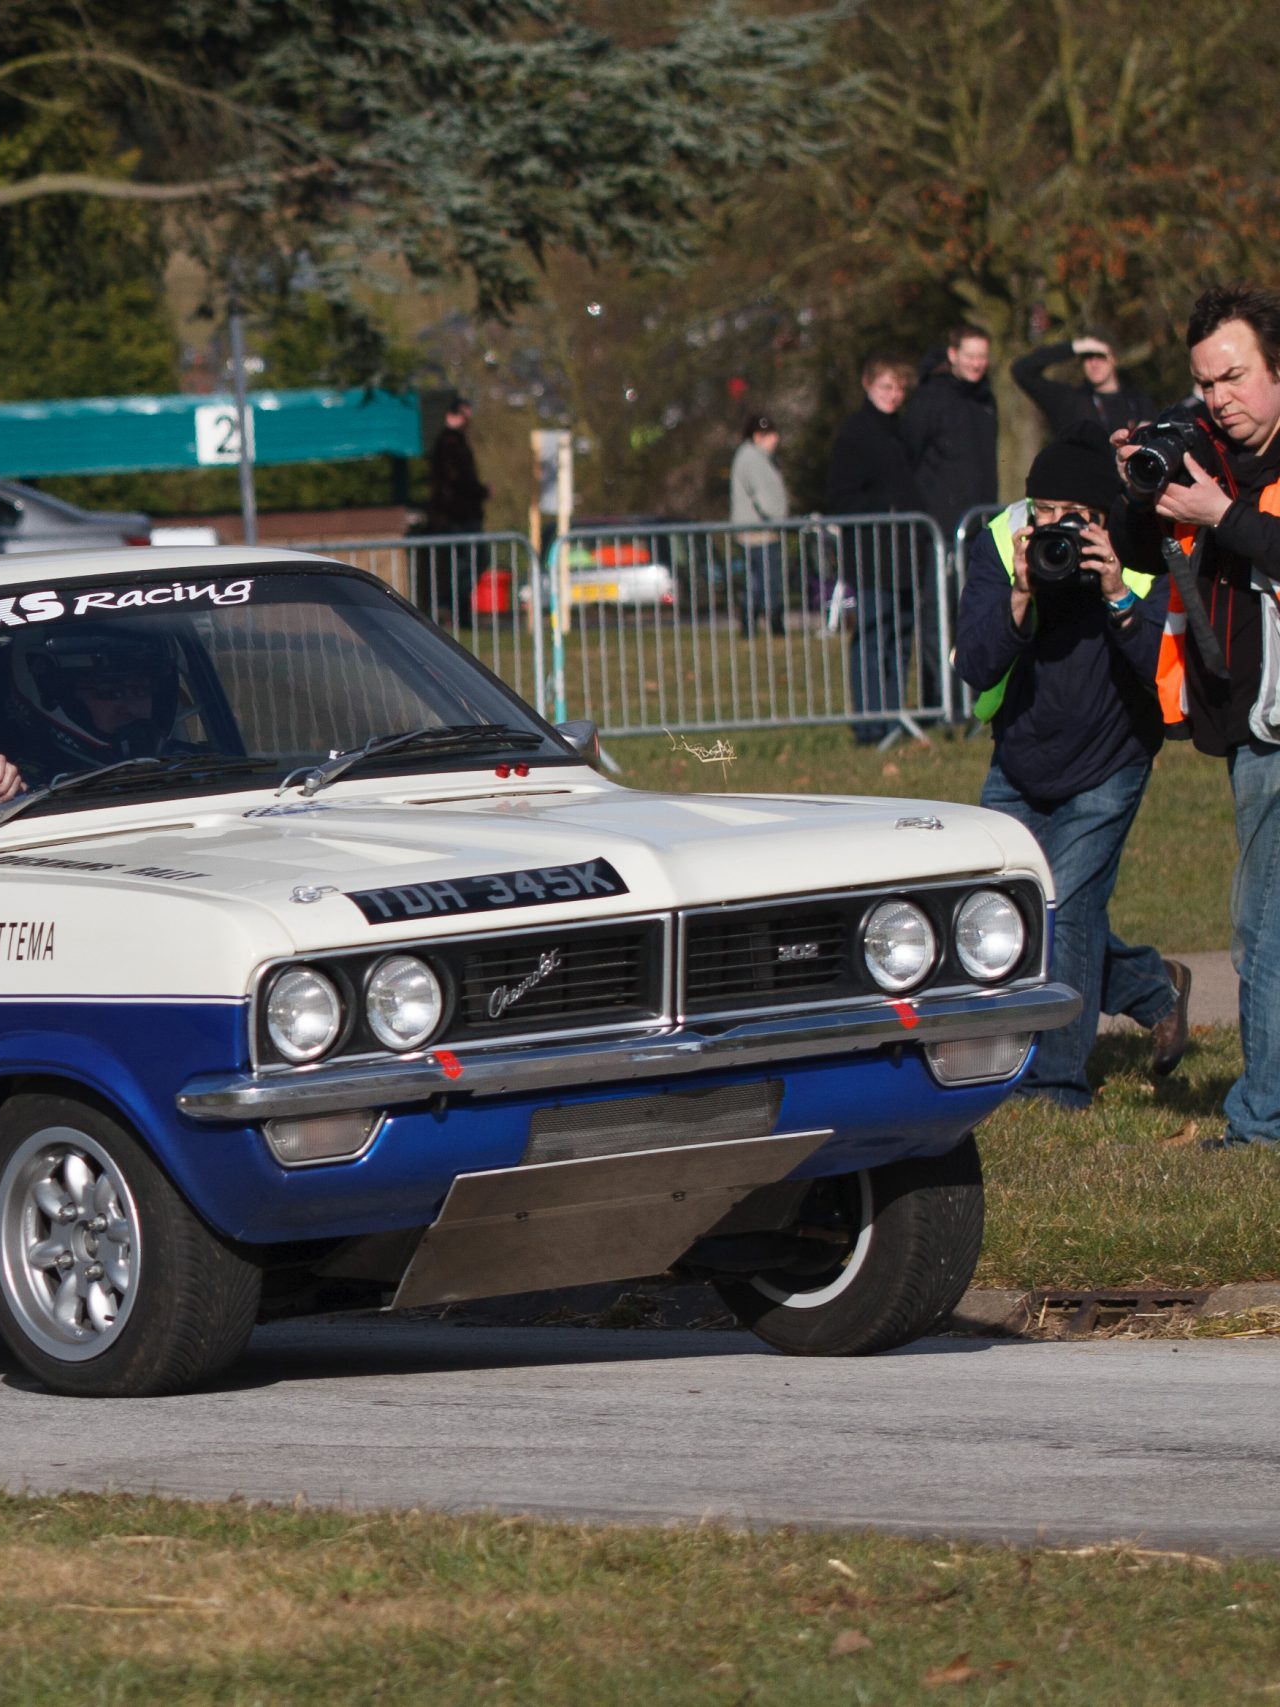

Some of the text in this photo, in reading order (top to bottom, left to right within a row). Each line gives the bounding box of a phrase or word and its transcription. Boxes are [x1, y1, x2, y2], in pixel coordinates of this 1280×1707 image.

[215, 415, 239, 454] 2
[73, 580, 255, 615] Racing
[354, 862, 616, 918] TDH 345K
